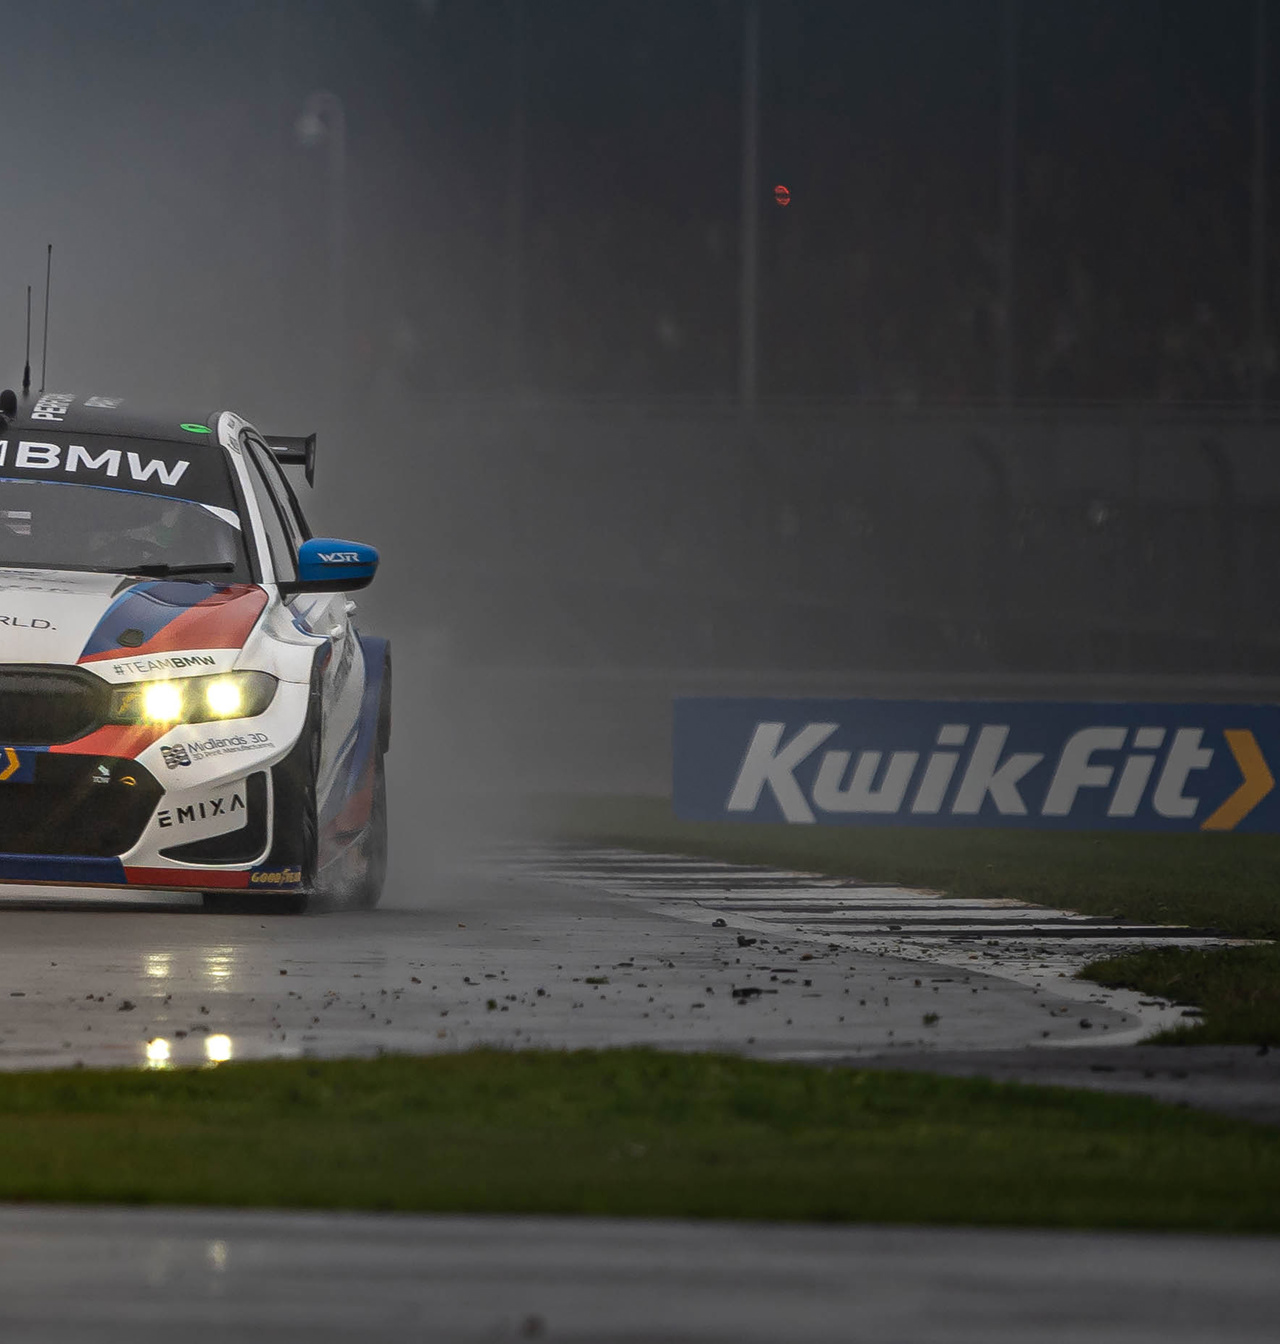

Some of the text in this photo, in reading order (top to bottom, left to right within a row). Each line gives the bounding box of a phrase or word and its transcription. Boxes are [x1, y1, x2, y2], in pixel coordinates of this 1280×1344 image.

[317, 552, 361, 563] WSR
[113, 655, 216, 675] #TEAMBMW
[187, 732, 269, 754] Midlands 3D
[157, 793, 245, 828] EMIXA
